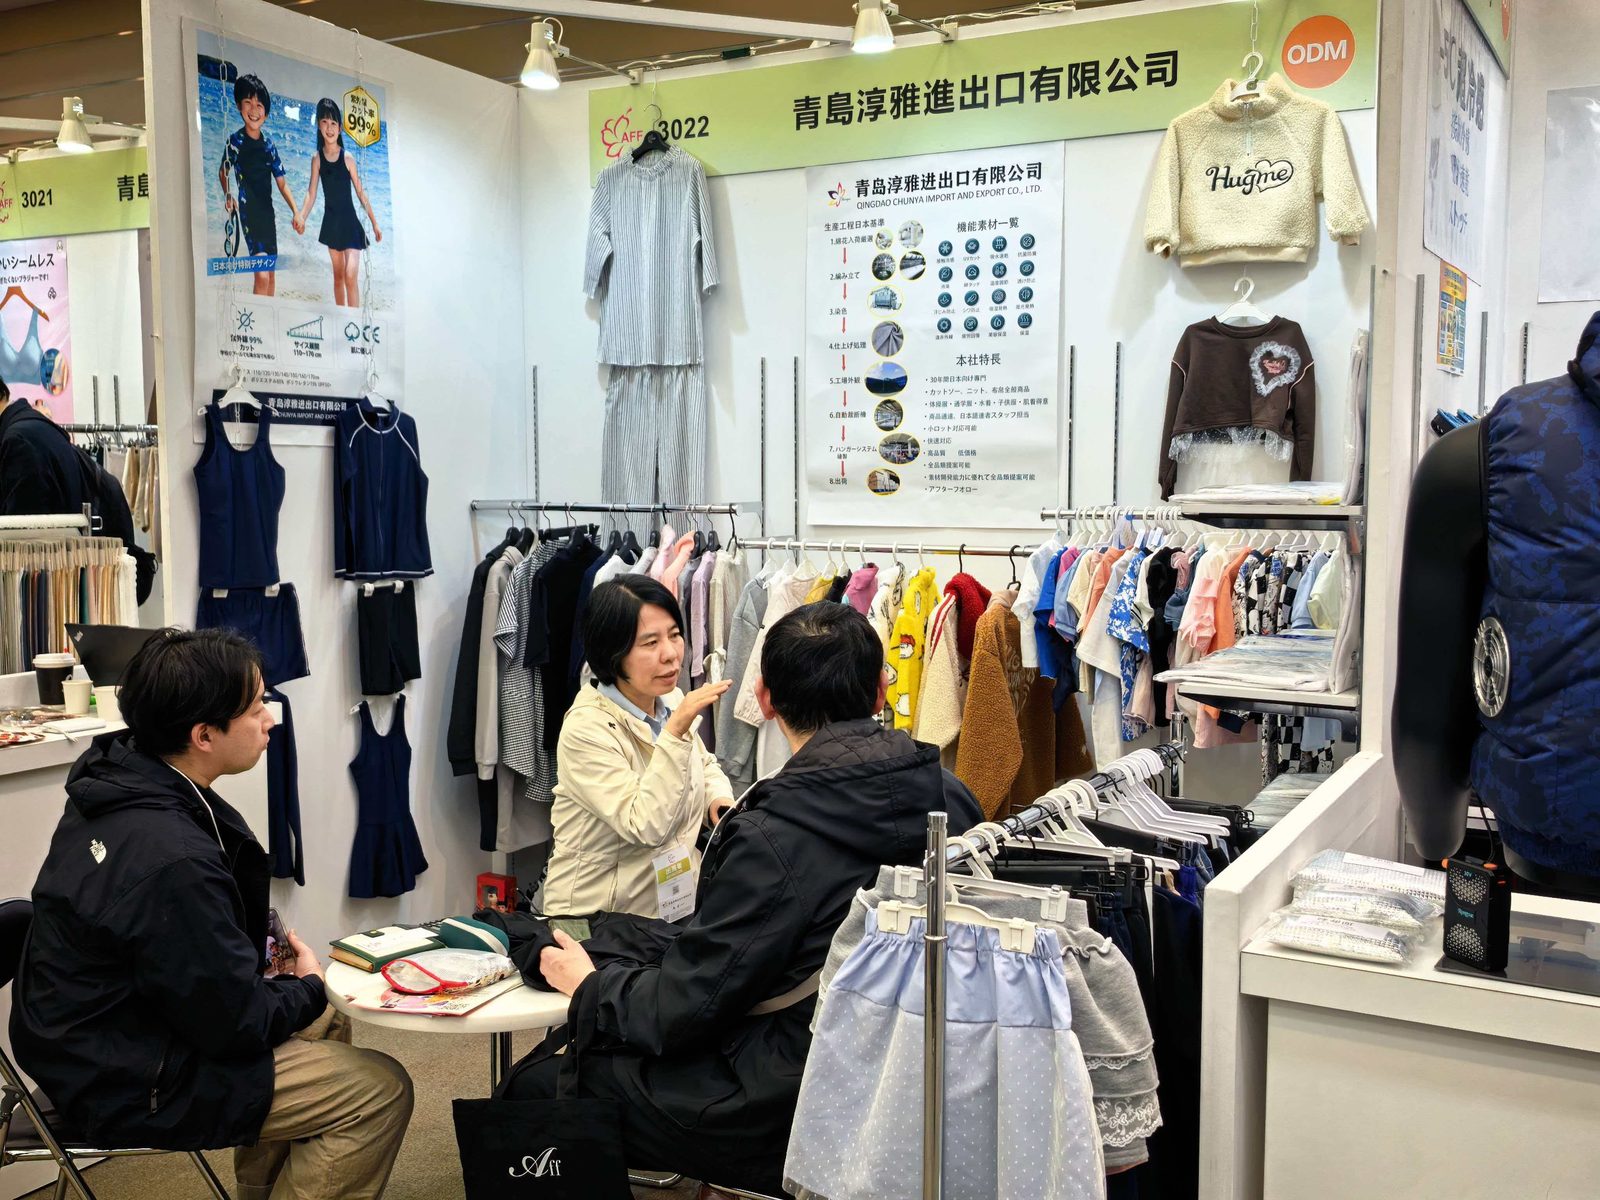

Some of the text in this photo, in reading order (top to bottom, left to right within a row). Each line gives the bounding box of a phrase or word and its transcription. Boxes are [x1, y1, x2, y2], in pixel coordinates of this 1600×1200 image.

[1286, 40, 1347, 65] ODM
[793, 50, 1178, 131] 青島淳雅進出口有限公司
[621, 130, 644, 144] AFF
[658, 116, 710, 142] 3022
[116, 173, 149, 202] 青島
[855, 162, 1042, 198] 青岛淳雅进出口有限公司
[21, 188, 53, 208] 3021
[856, 198, 891, 210] QINGDAO
[892, 196, 924, 206] CHUNYA
[925, 192, 956, 204] IMPORT
[958, 190, 974, 200] AND
[976, 187, 1006, 198] EXPORT
[1026, 184, 1042, 194] LTD.
[824, 218, 885, 232] 生産工程日本基準
[957, 217, 1020, 232] 機能素材一覧
[0, 253, 54, 270] いシームレス
[956, 353, 1001, 366] 本社特長
